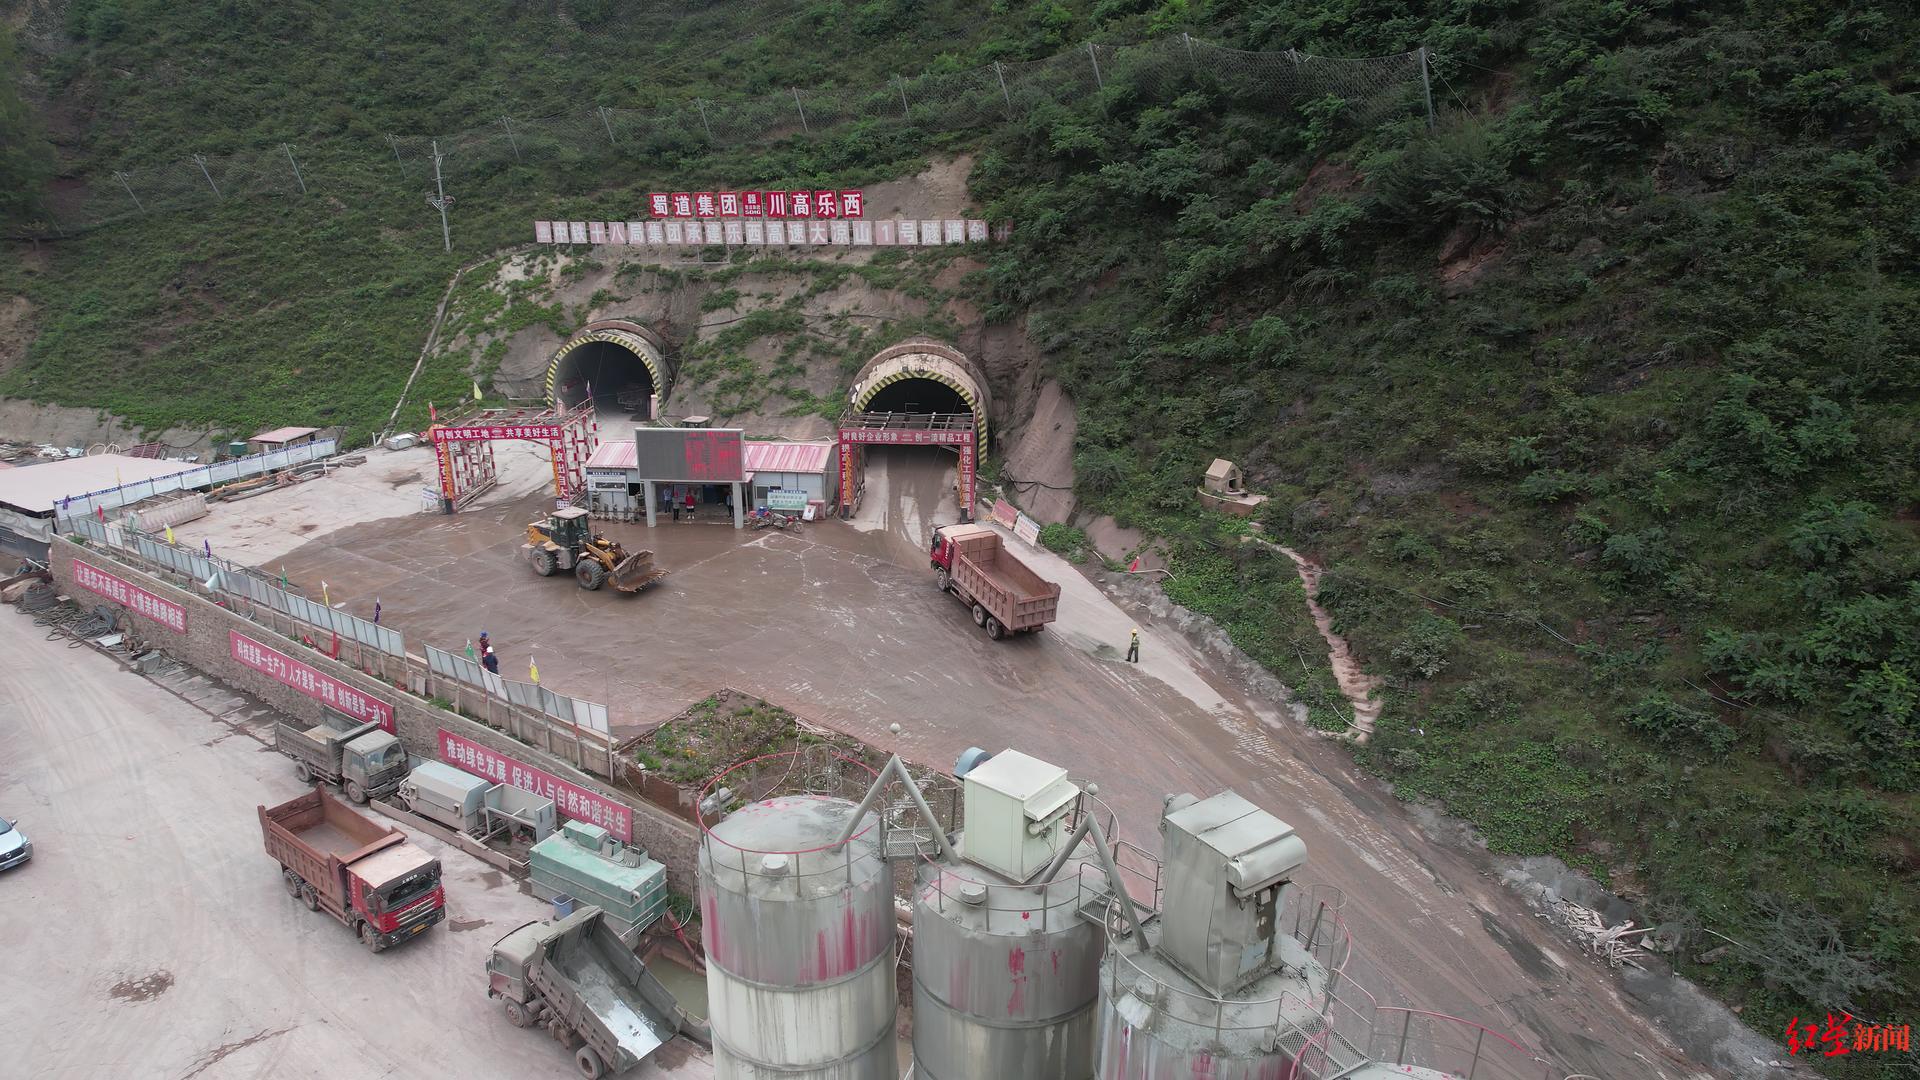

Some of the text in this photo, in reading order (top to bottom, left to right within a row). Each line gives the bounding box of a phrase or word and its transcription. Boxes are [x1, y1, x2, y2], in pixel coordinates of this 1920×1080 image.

[653, 193, 860, 216] 蜀道集团 川高乐西
[436, 429, 490, 439] 同创文明工地
[506, 427, 559, 439] 共享美好生活
[842, 431, 971, 443] 树良好企业形象 创一流精品工程
[551, 439, 570, 500] 事故出自大
[237, 639, 387, 727] 科技是第一生产力 人才是第一资源 创新是第一动力
[446, 736, 627, 836] 推动绿色发展 促进人与自然和谐共生
